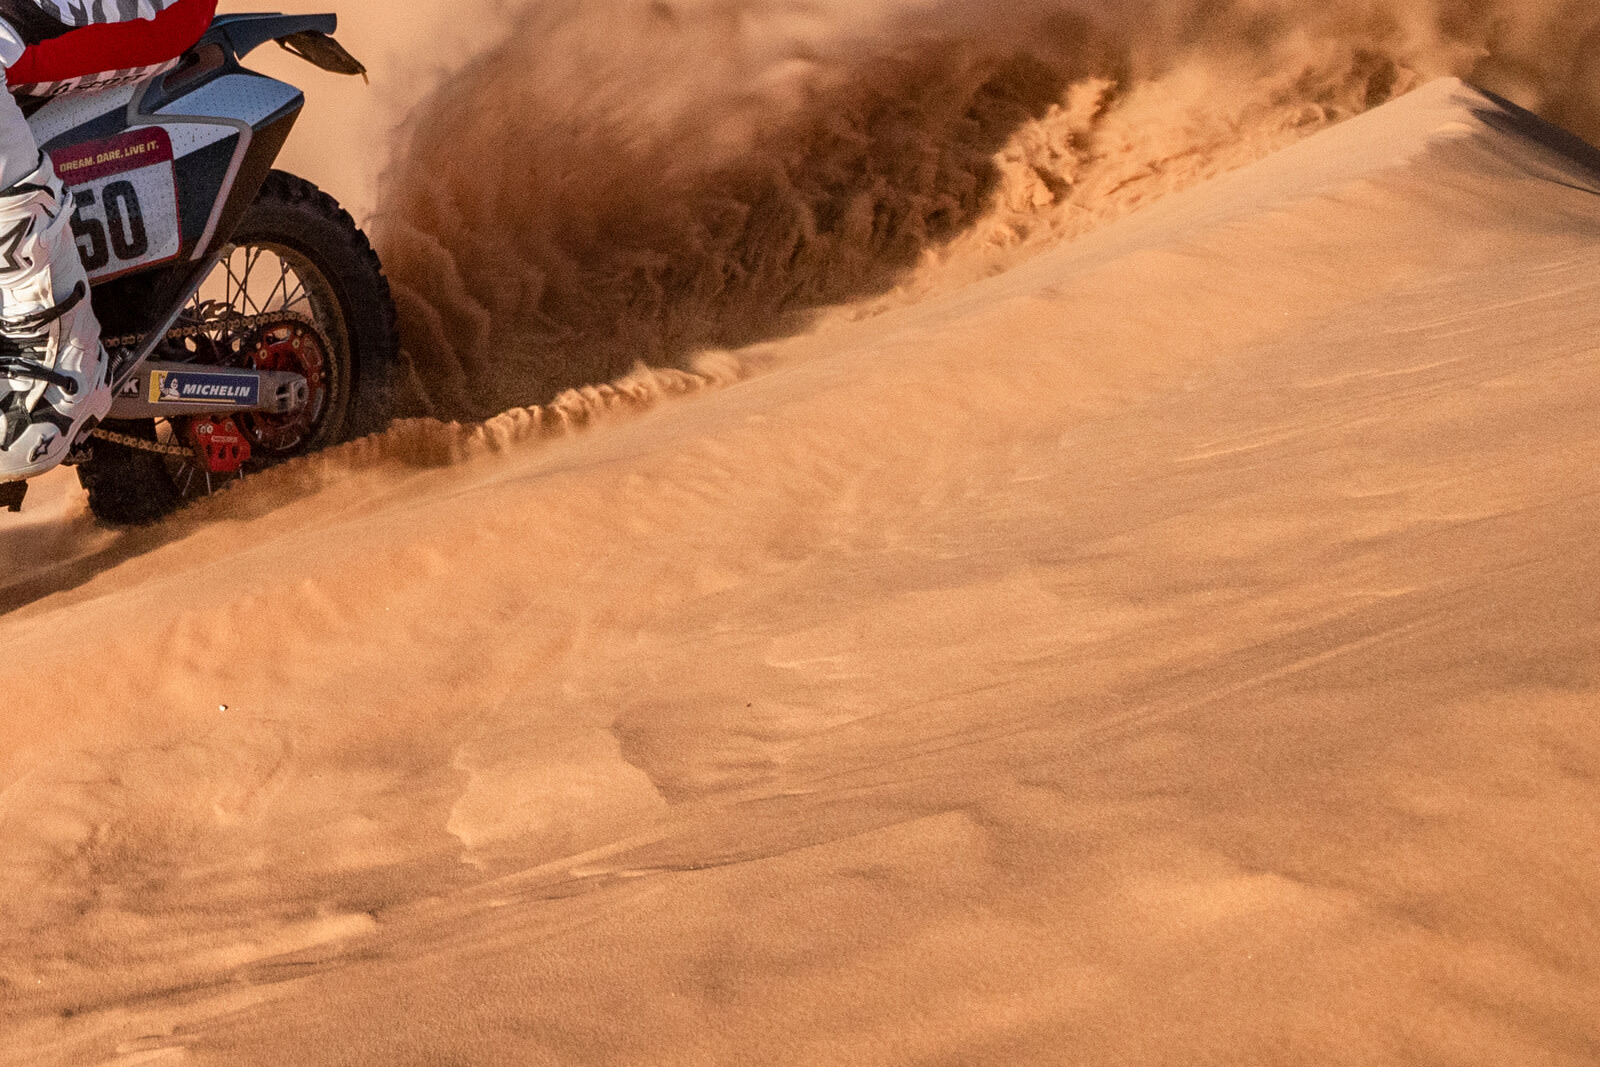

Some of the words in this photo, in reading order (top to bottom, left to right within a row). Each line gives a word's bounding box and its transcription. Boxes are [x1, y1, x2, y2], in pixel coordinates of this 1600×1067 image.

[59, 156, 95, 172] DREAM.
[96, 149, 124, 165] DARE.
[124, 143, 146, 157] LIVE
[146, 140, 160, 152] IT.
[69, 180, 148, 272] 50
[182, 383, 251, 397] MICHELIN
